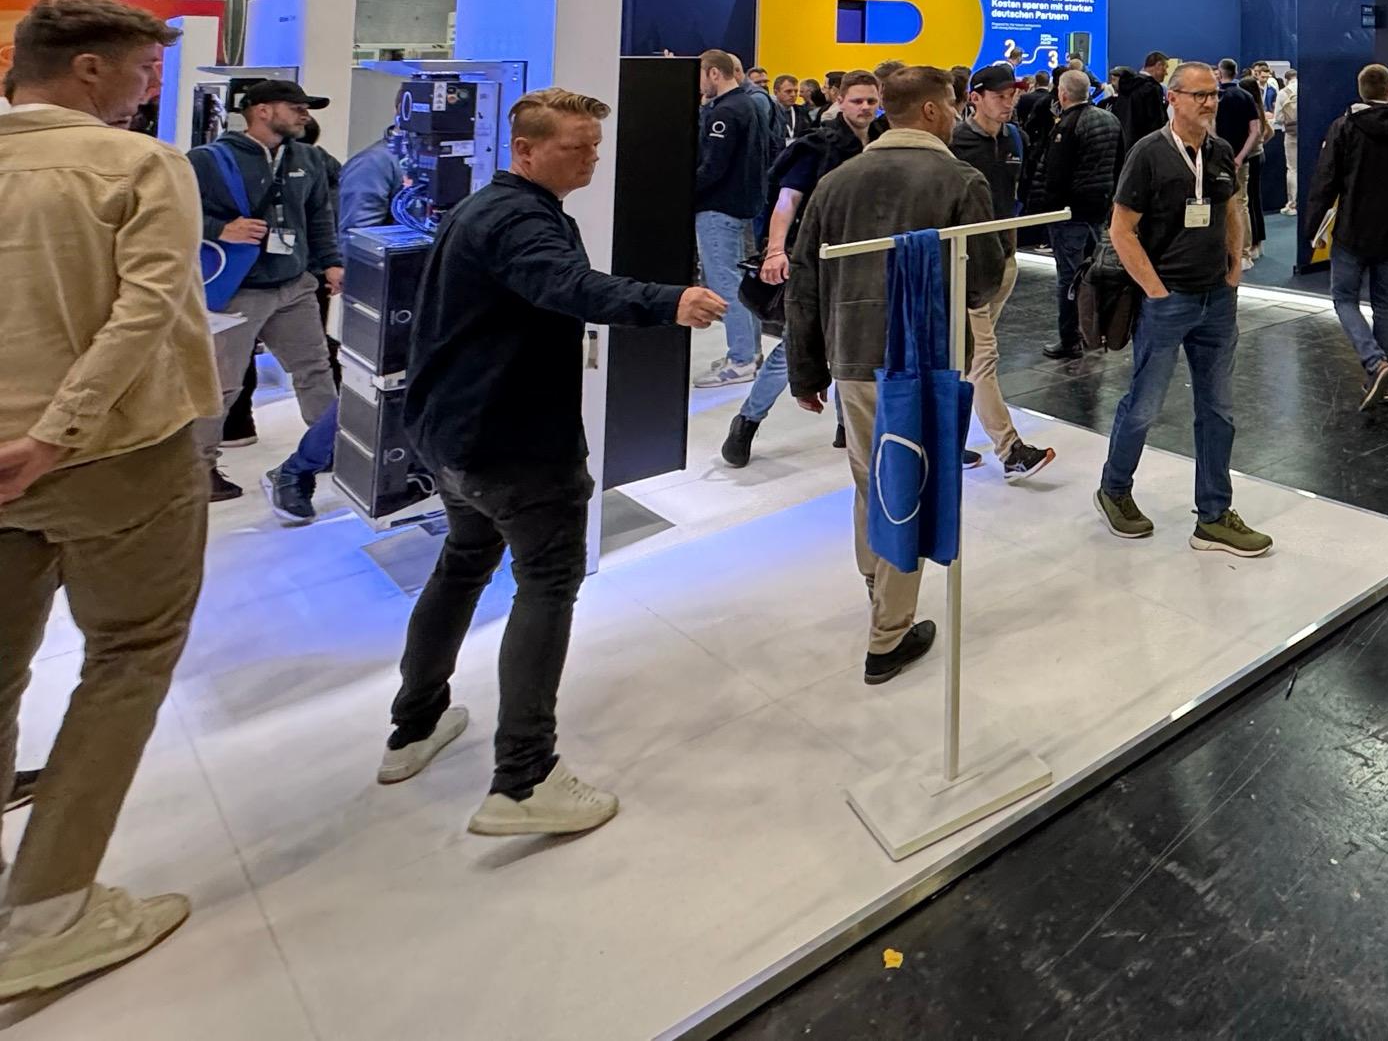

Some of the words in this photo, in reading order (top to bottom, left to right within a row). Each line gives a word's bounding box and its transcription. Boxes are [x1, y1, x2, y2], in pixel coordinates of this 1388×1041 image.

[991, 0, 1020, 8] Kosten
[1022, 1, 1049, 11] sparen
[1050, 2, 1063, 11] mit
[1064, 3, 1093, 13] starken
[991, 9, 1034, 19] deutschen
[1035, 11, 1069, 21] Partnern
[1048, 50, 1059, 68] 3
